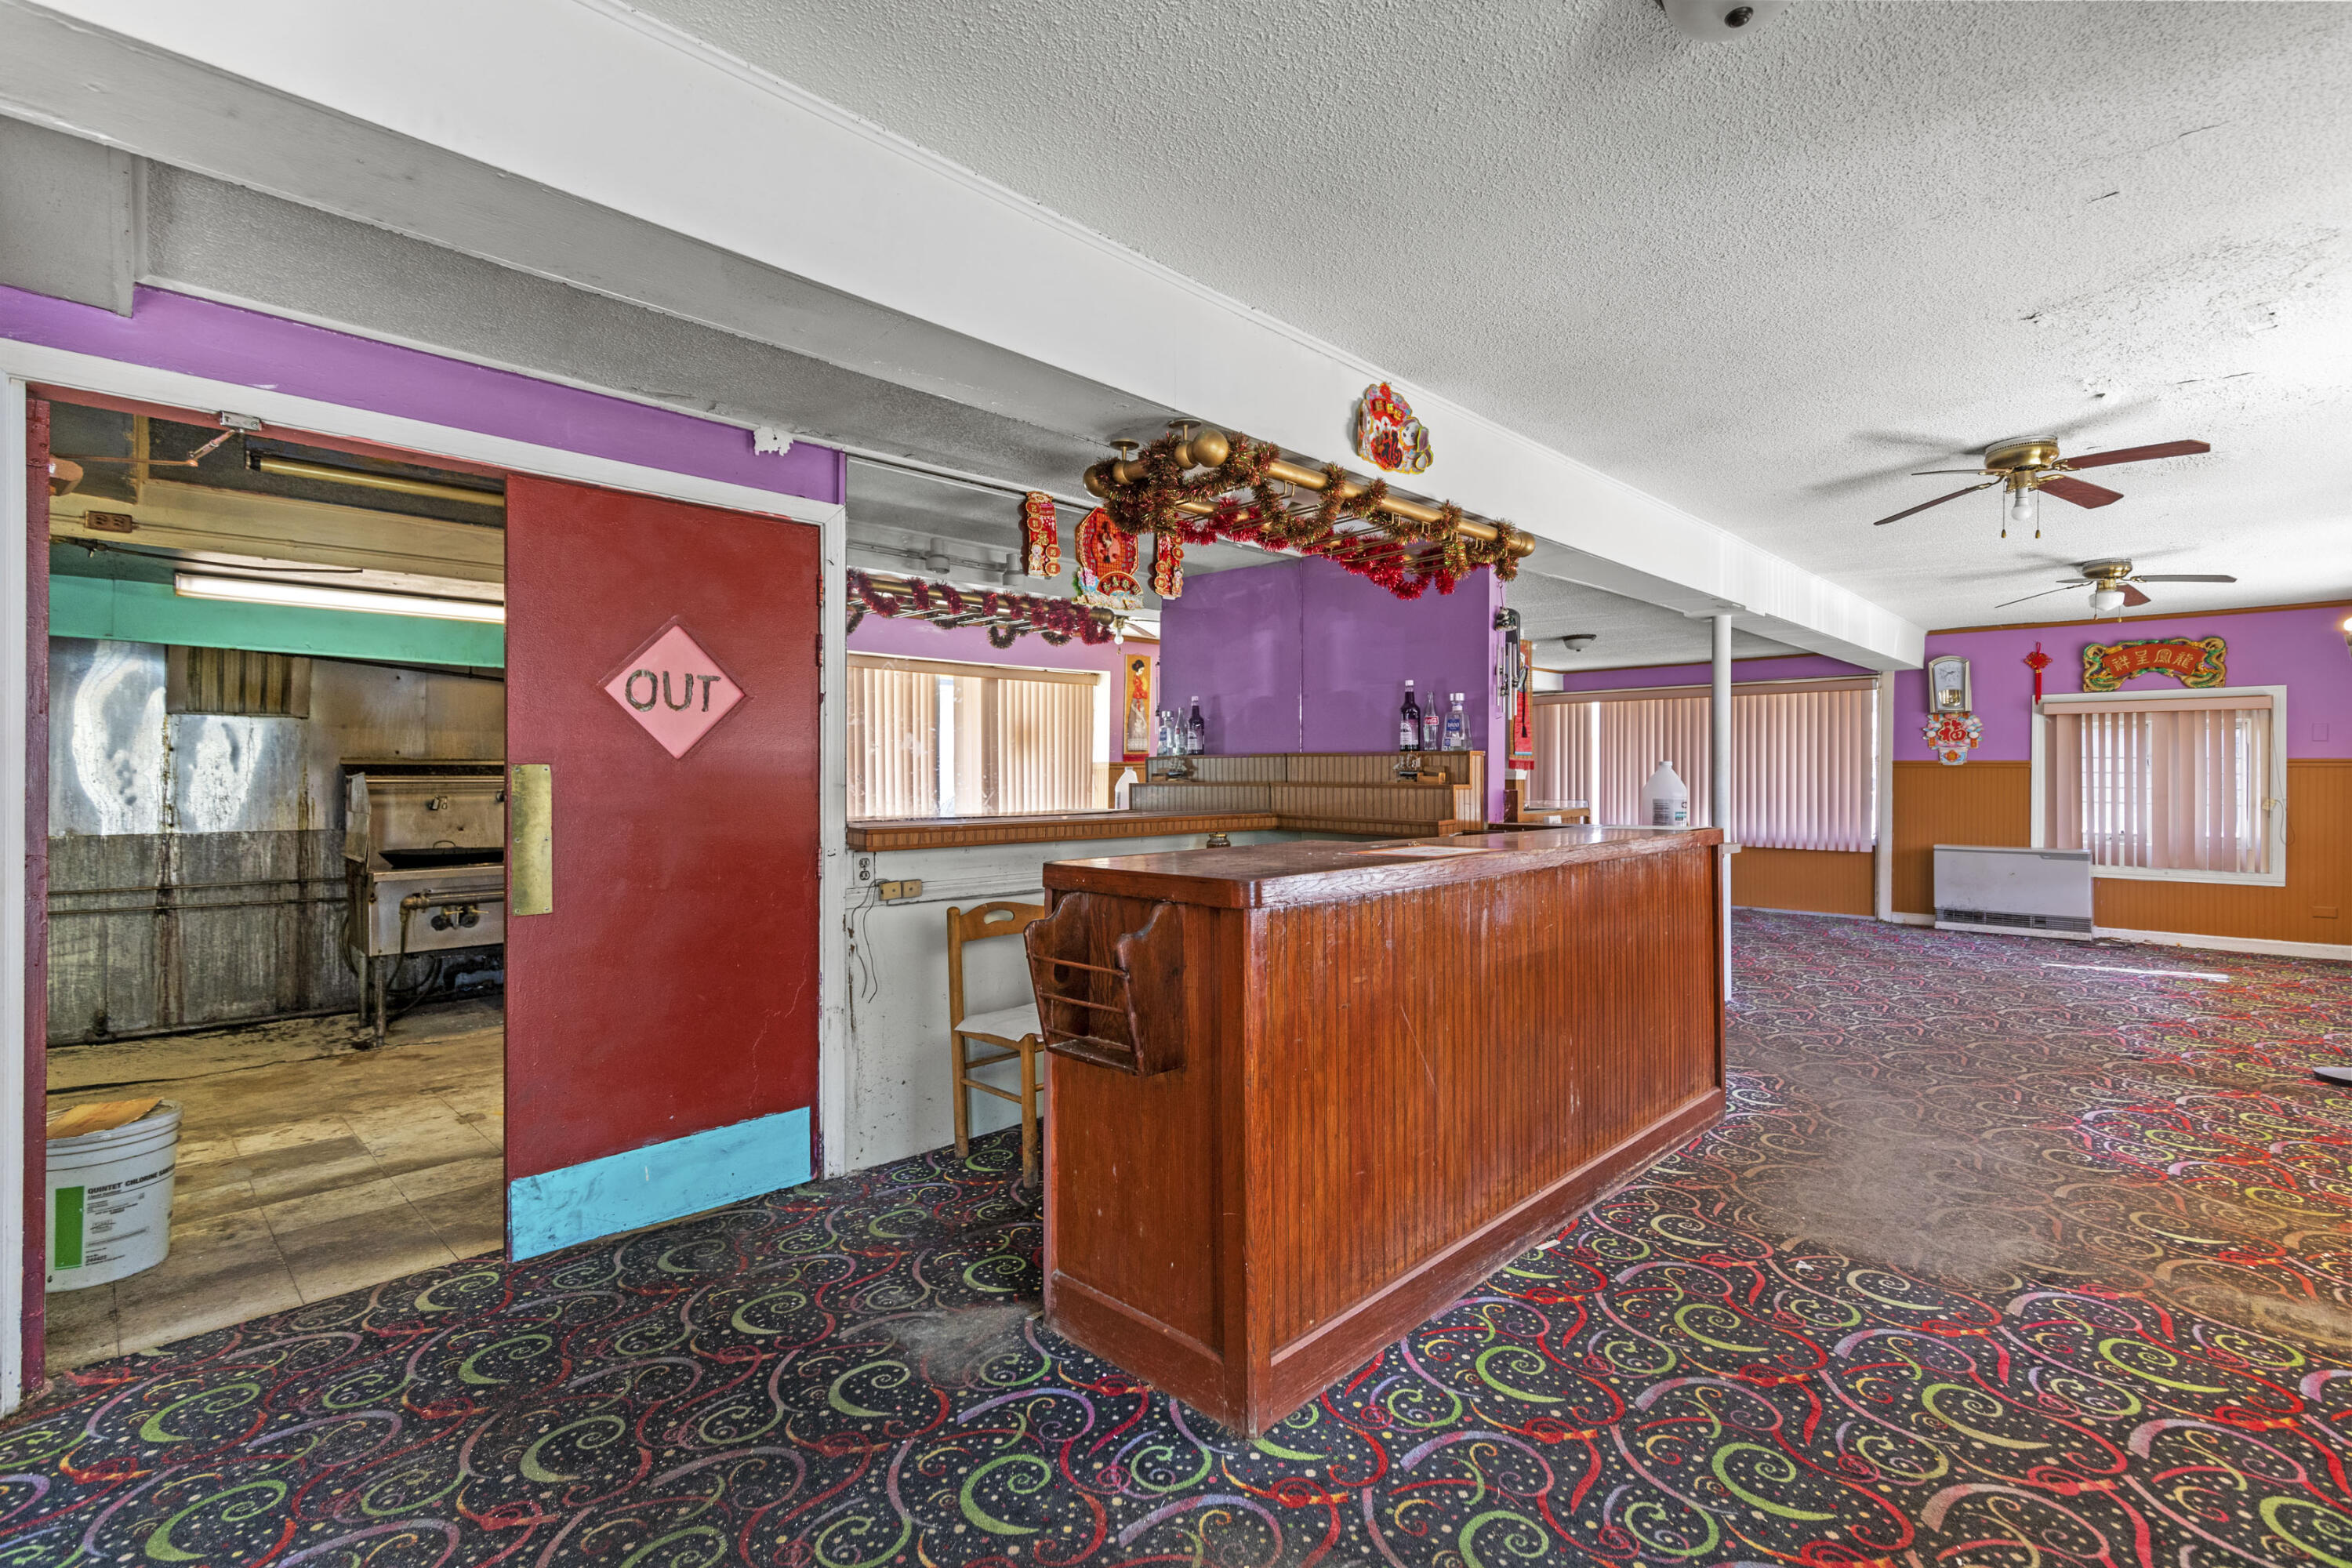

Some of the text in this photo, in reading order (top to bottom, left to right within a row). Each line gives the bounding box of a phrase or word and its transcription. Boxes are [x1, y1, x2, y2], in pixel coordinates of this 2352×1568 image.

[625, 669, 721, 713] OUT
[1940, 719, 1967, 742] 福
[88, 1181, 123, 1194] QUINTET
[125, 1171, 158, 1186] CHLORINE
